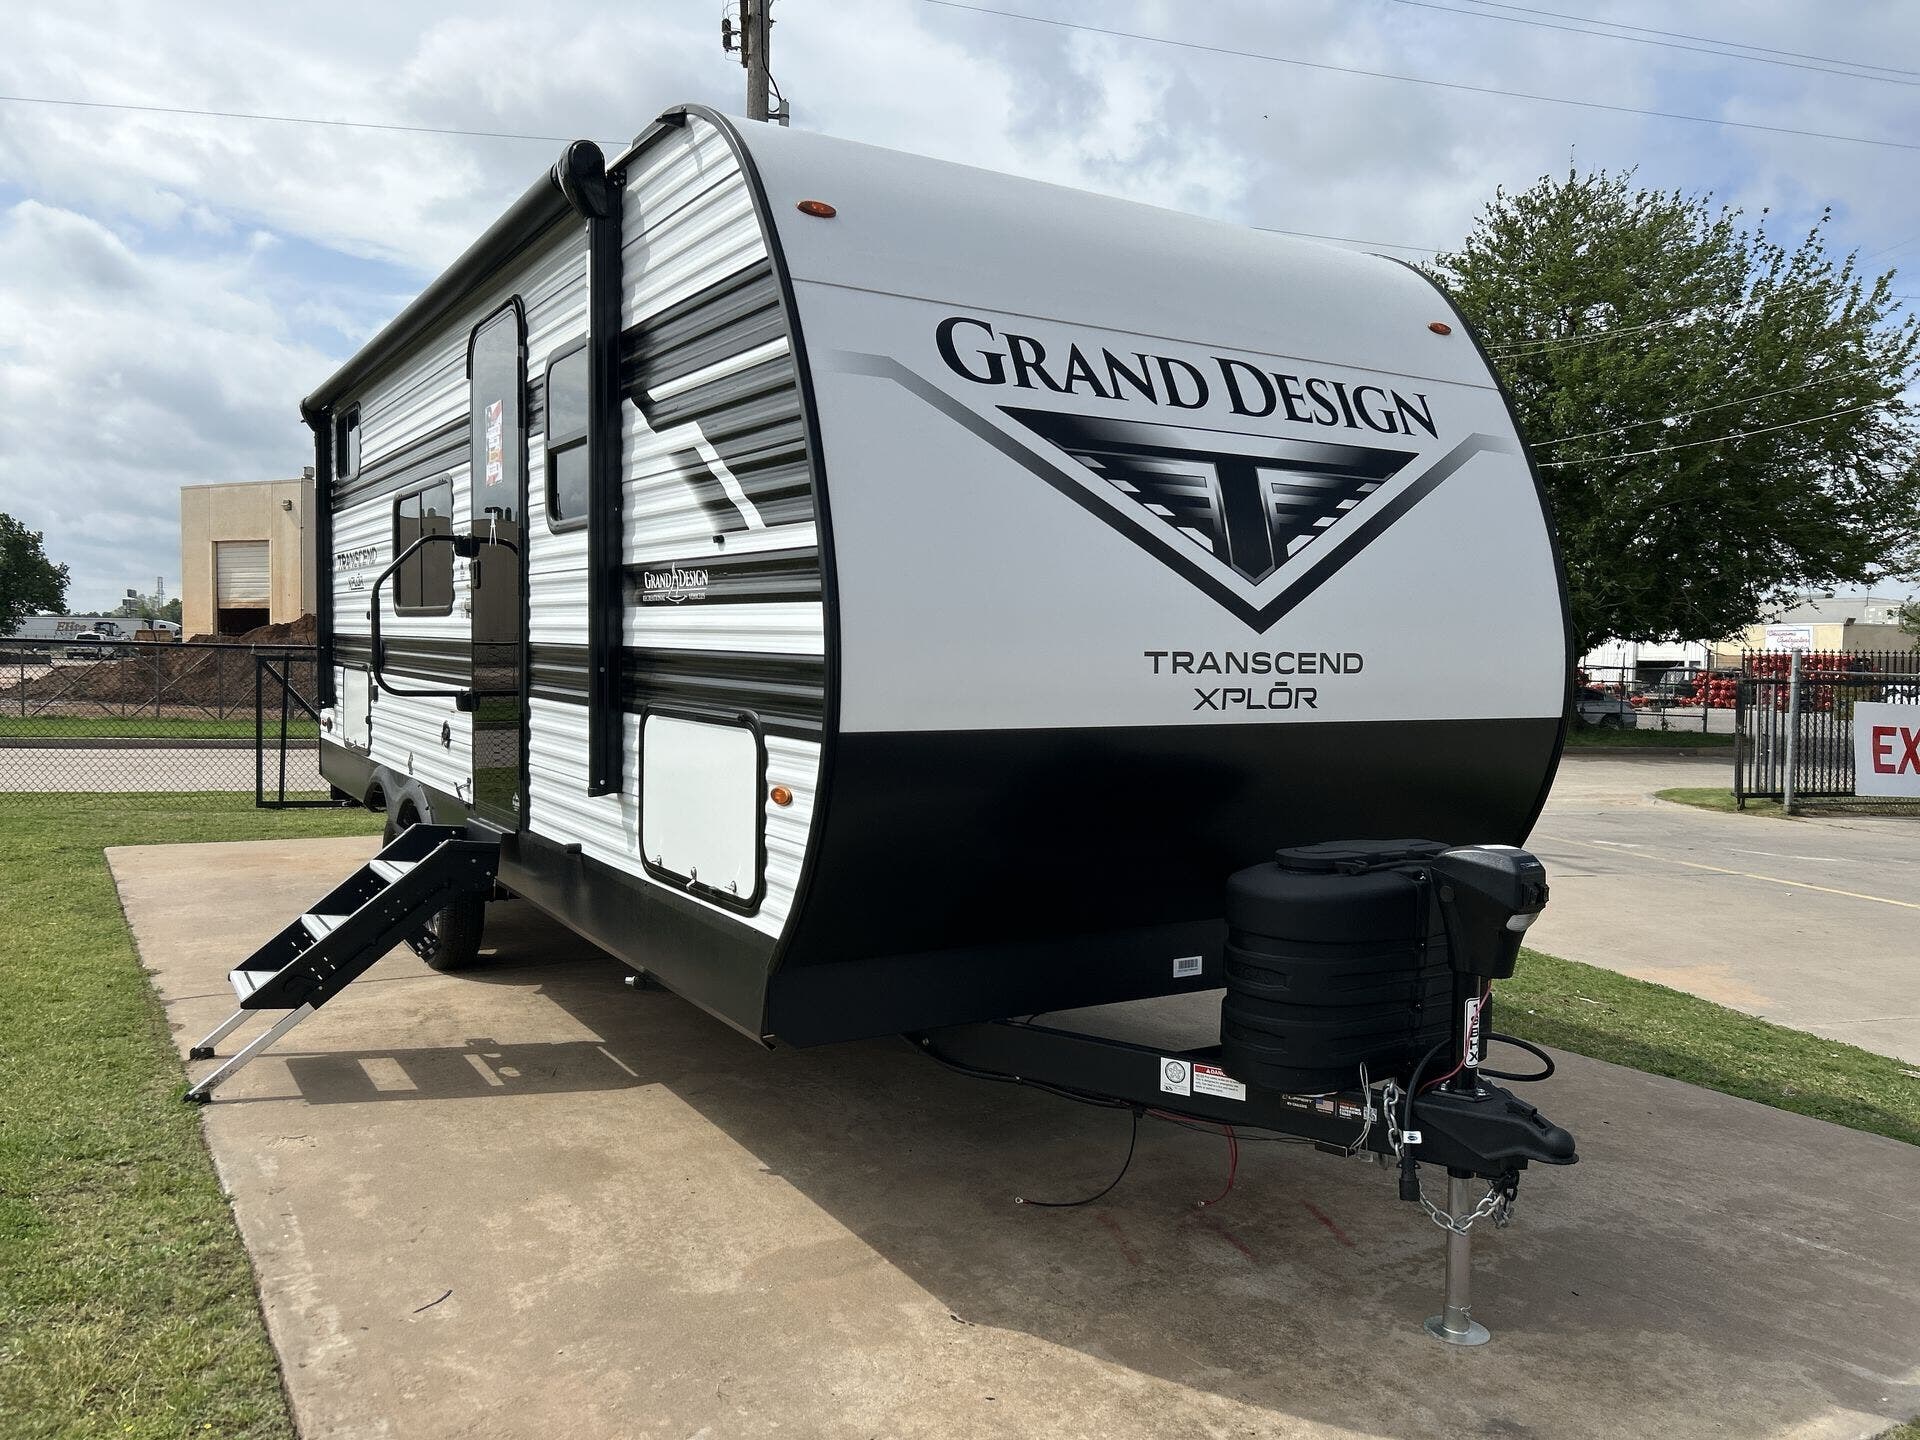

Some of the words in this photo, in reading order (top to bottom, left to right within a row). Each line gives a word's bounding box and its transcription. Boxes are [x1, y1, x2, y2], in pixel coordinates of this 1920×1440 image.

[935, 316, 1210, 410] GRAND
[1209, 356, 1439, 440] DESIGN
[644, 571, 672, 589] GRAND
[677, 569, 709, 587] DESIGN
[1143, 651, 1364, 675] TRANSCEND
